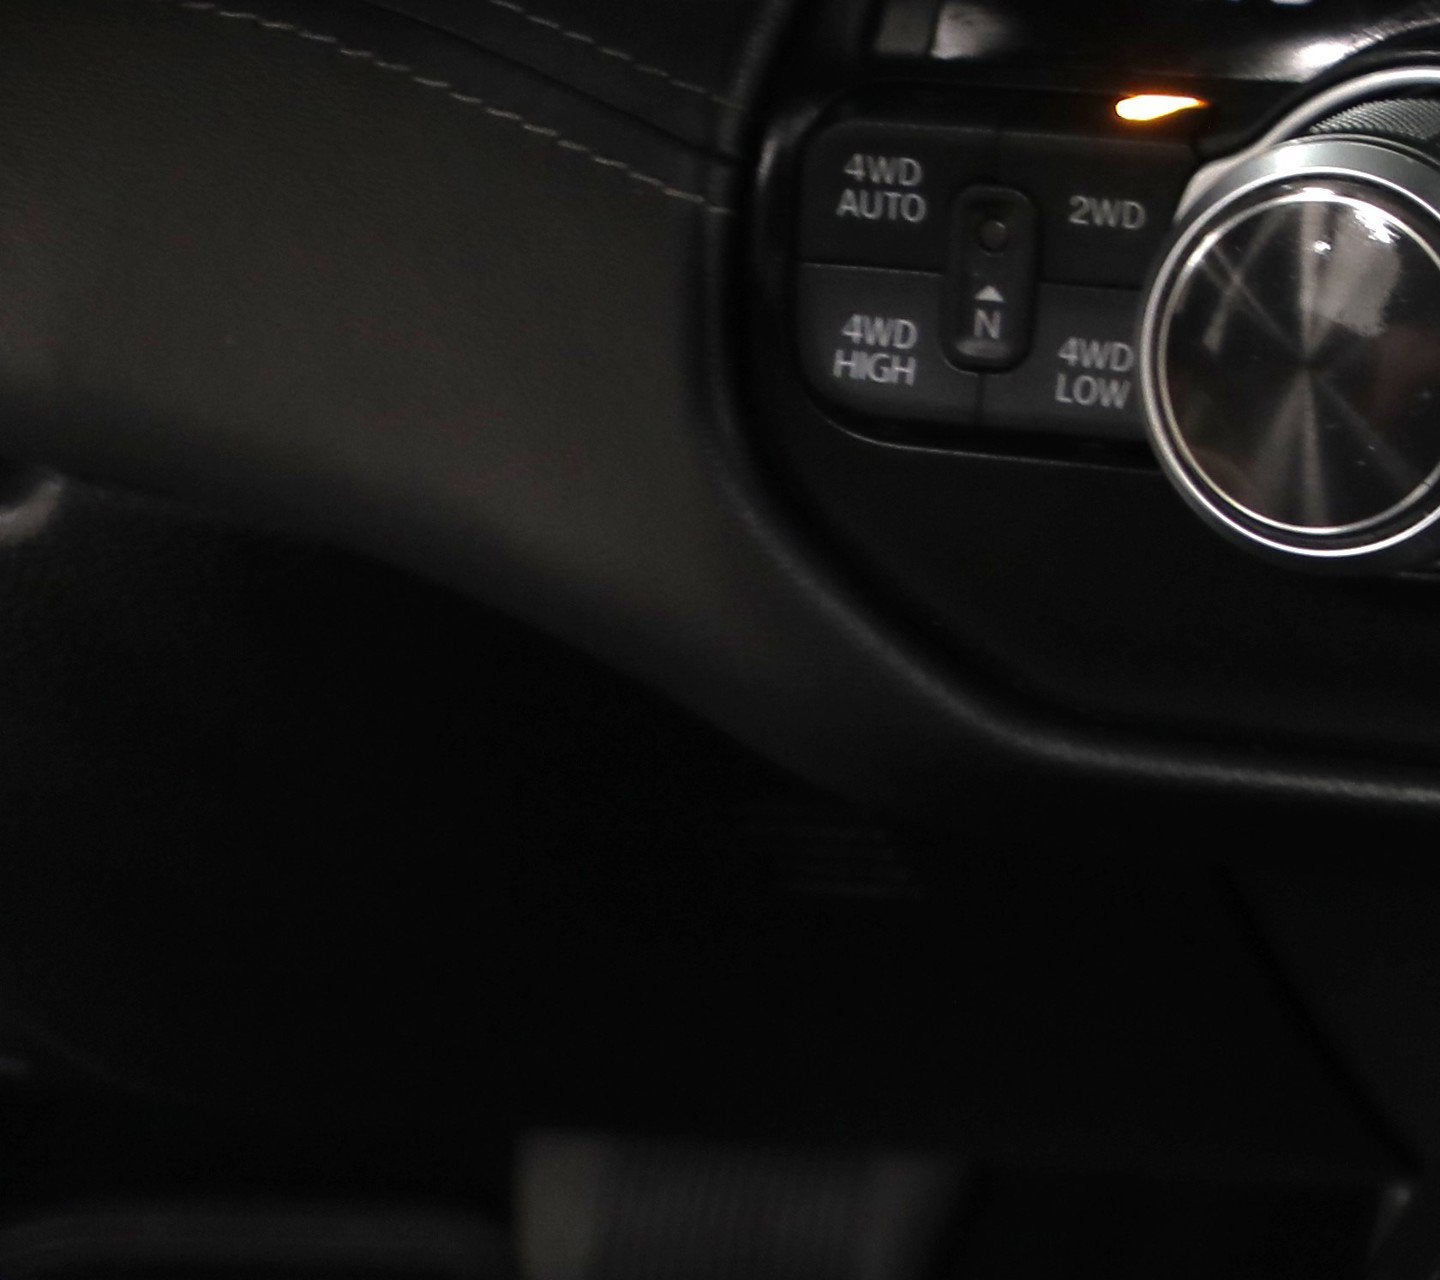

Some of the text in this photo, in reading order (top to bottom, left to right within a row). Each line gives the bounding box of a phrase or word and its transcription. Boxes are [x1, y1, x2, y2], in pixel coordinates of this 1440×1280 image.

[842, 153, 923, 187] 4WD
[836, 188, 927, 225] AUTO
[1068, 196, 1147, 230] 2WD
[841, 313, 920, 349] 4WD
[972, 308, 1003, 341] N
[833, 352, 918, 388] HIGH
[1058, 337, 1134, 372] 4WD
[1055, 375, 1131, 410] LOW
